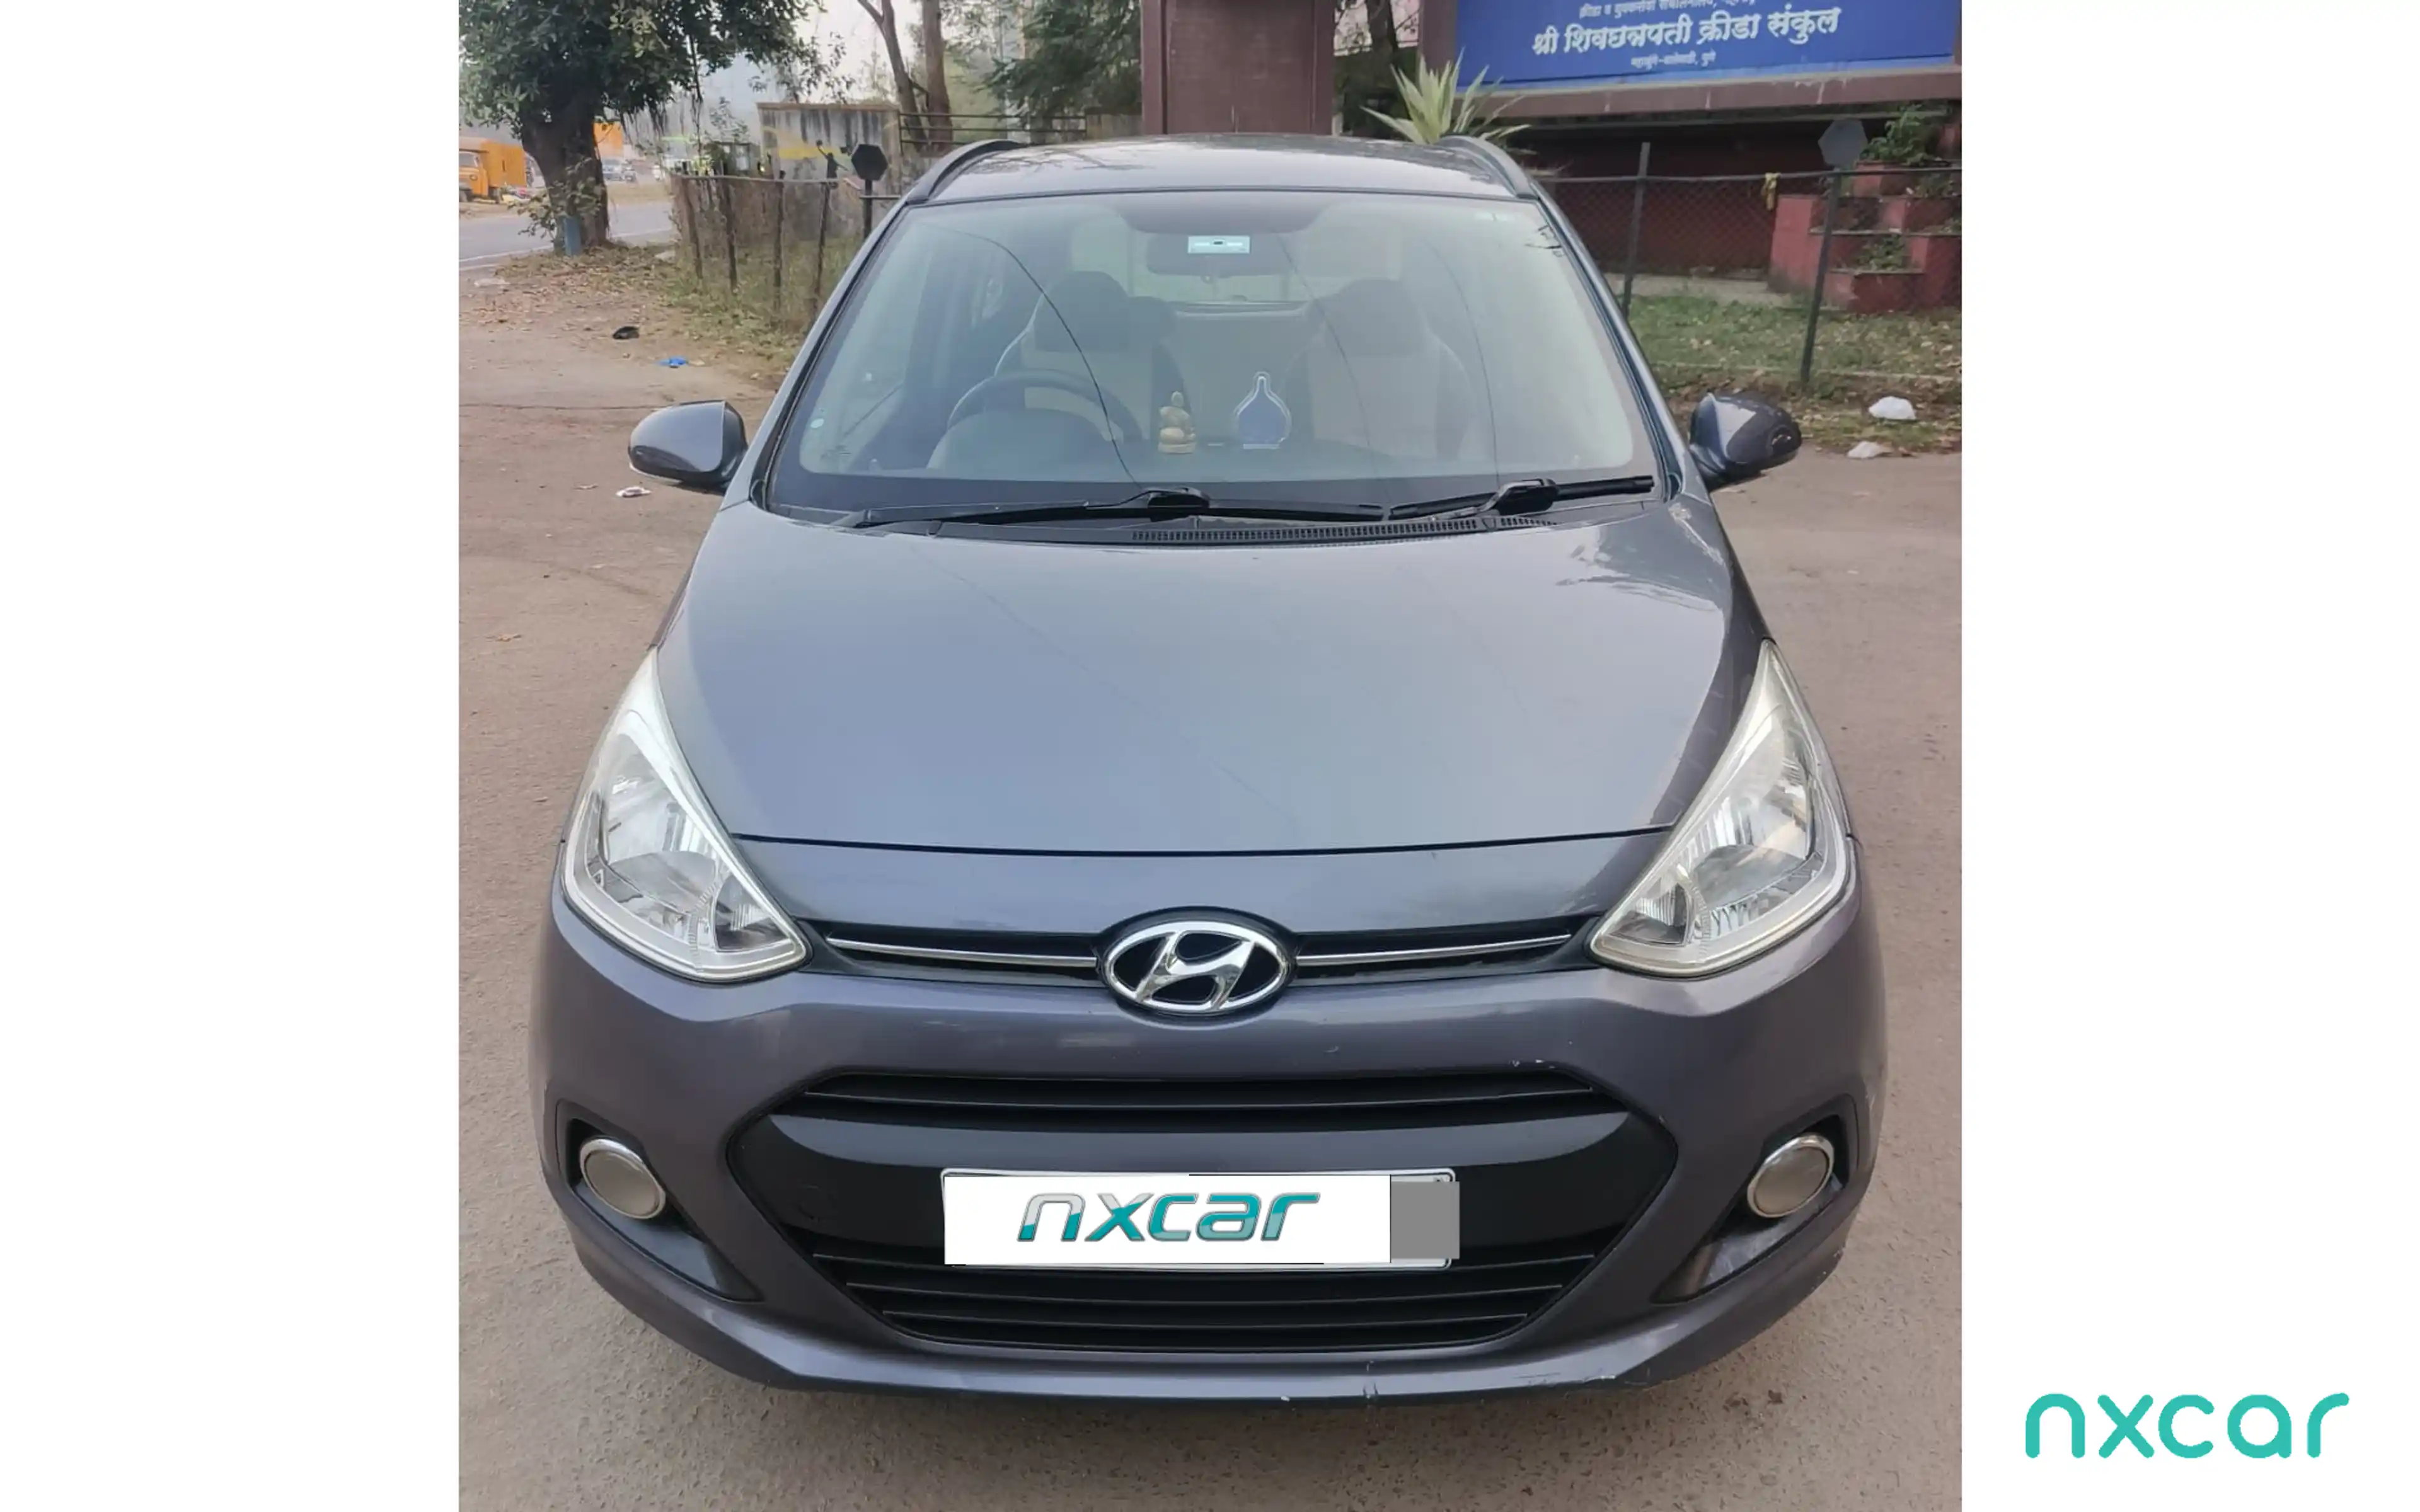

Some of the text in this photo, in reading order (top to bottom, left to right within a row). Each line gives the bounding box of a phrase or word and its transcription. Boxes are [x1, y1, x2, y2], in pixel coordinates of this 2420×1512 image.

[1532, 24, 1559, 55] श्री
[1697, 9, 1761, 45] क्रीडा
[1767, 3, 1841, 44] संकुल
